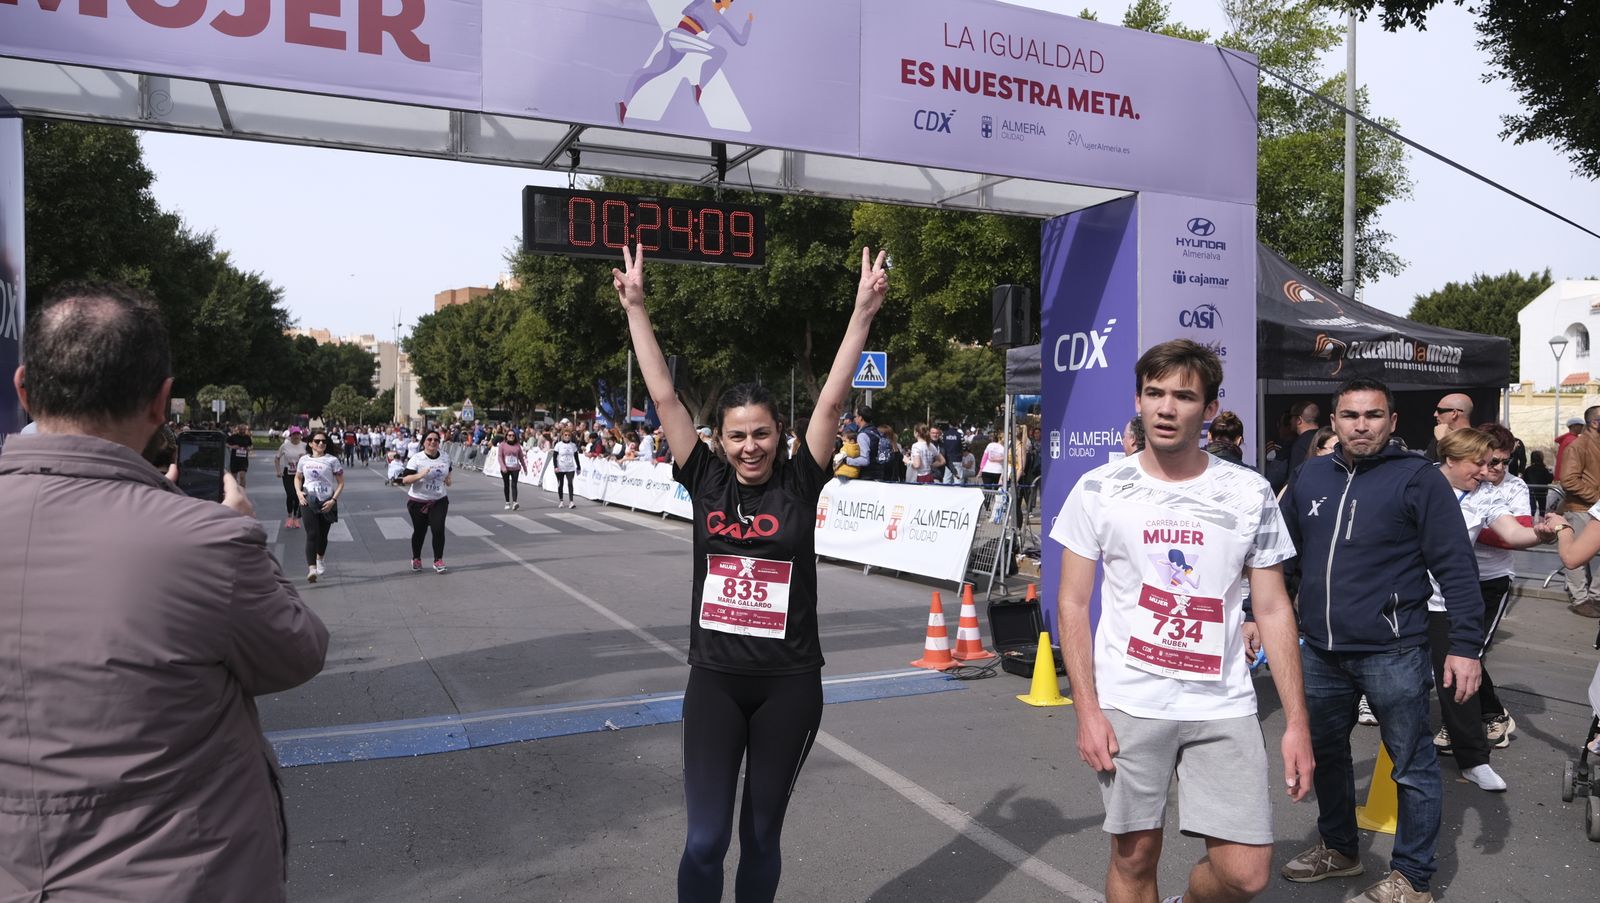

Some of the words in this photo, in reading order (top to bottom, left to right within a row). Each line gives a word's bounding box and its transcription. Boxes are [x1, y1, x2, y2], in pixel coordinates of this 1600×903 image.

[944, 22, 975, 52] LA
[983, 29, 1105, 74] IGUALDAD
[901, 58, 935, 87] ES
[942, 64, 1063, 109] NUESTRA
[1067, 87, 1141, 120] META.
[913, 109, 957, 134] CDX
[1001, 119, 1046, 136] ALMERÍA
[1000, 131, 1025, 142] CIUDAD
[568, 197, 754, 257] 00:24:09
[1176, 237, 1226, 251] HYUNDAI
[1182, 249, 1221, 261] Almerialva
[1189, 273, 1229, 286] cajamar
[1054, 319, 1117, 373] CDX
[1068, 428, 1123, 446] ALMERÍA
[1068, 447, 1095, 457] CIUDAD
[836, 498, 885, 522] ALMERÍA
[910, 506, 971, 530] ALMERÍA
[833, 518, 858, 532] CIUDAD
[1145, 519, 1178, 527] CARRERA
[909, 528, 938, 543] CIUDAD
[1143, 529, 1204, 546] MUJER
[722, 578, 768, 602] 835
[738, 600, 772, 609] GALLARDO
[1149, 596, 1169, 607] MUJER
[1152, 613, 1203, 643] 734
